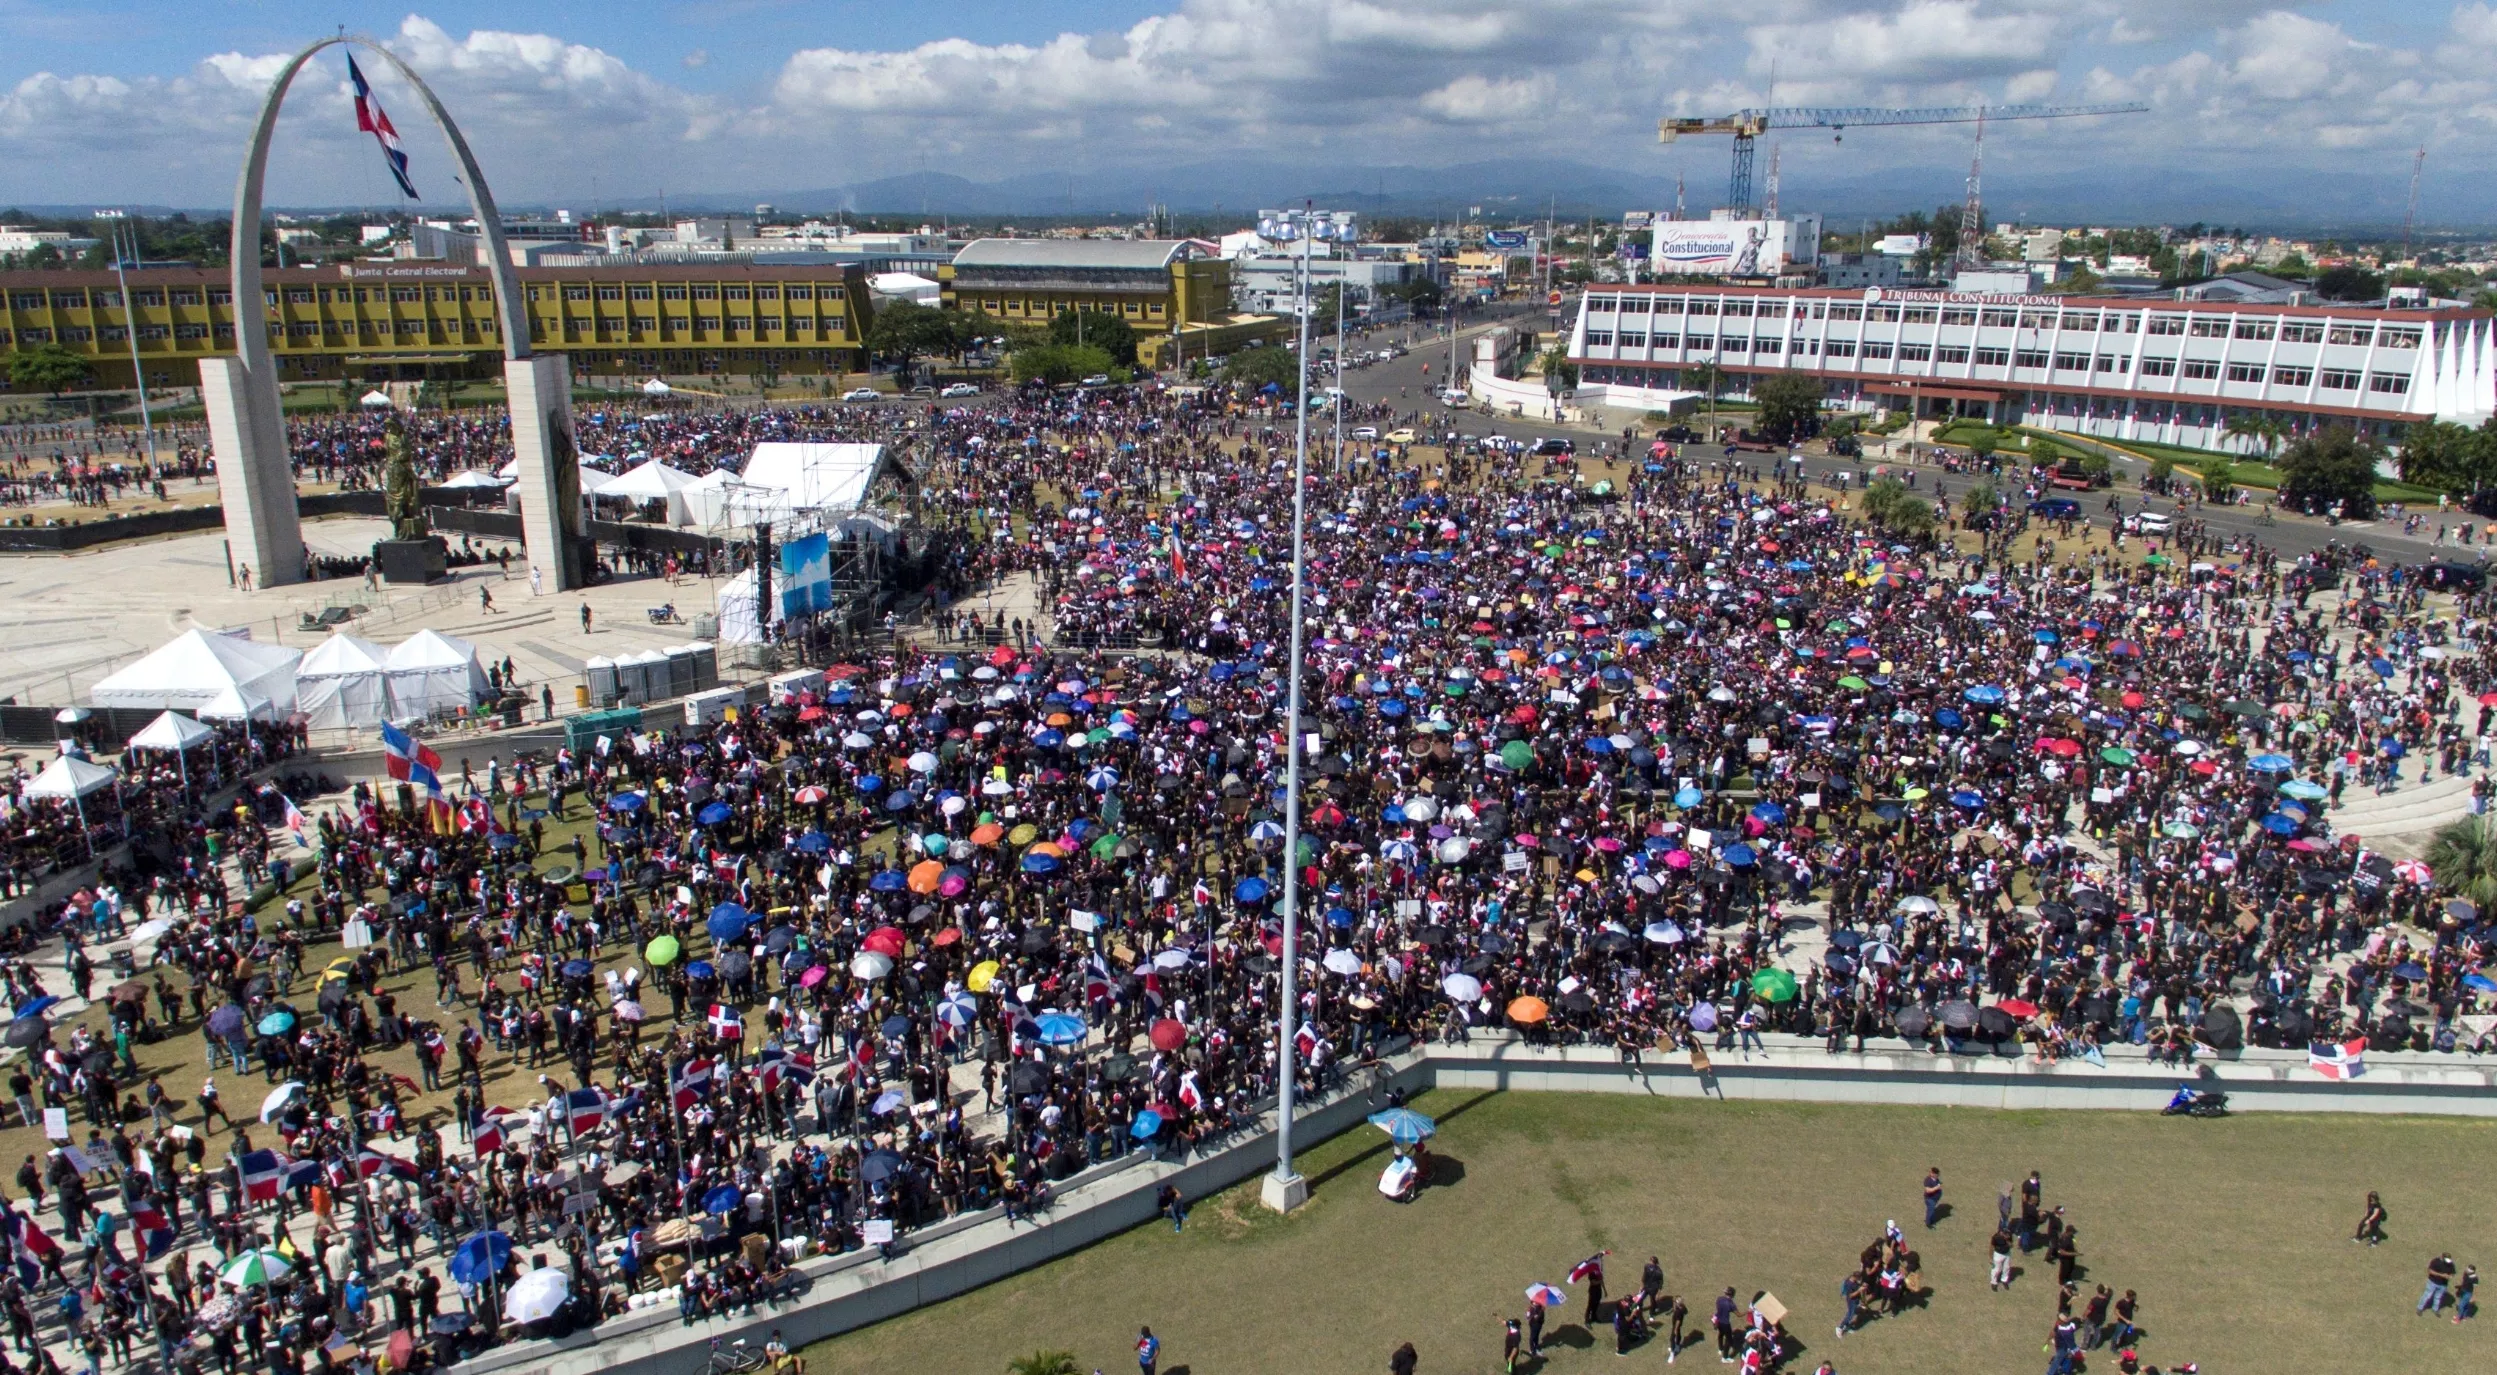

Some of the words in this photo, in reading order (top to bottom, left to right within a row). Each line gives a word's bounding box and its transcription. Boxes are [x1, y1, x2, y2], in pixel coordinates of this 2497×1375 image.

[1662, 240, 1734, 253] Constitucional
[355, 267, 382, 277] Junta
[386, 267, 423, 276] Central
[425, 266, 467, 276] Electoral
[1886, 289, 1946, 302] TRIBUNAL
[1949, 291, 2063, 306] CONSTITUCIONAL
